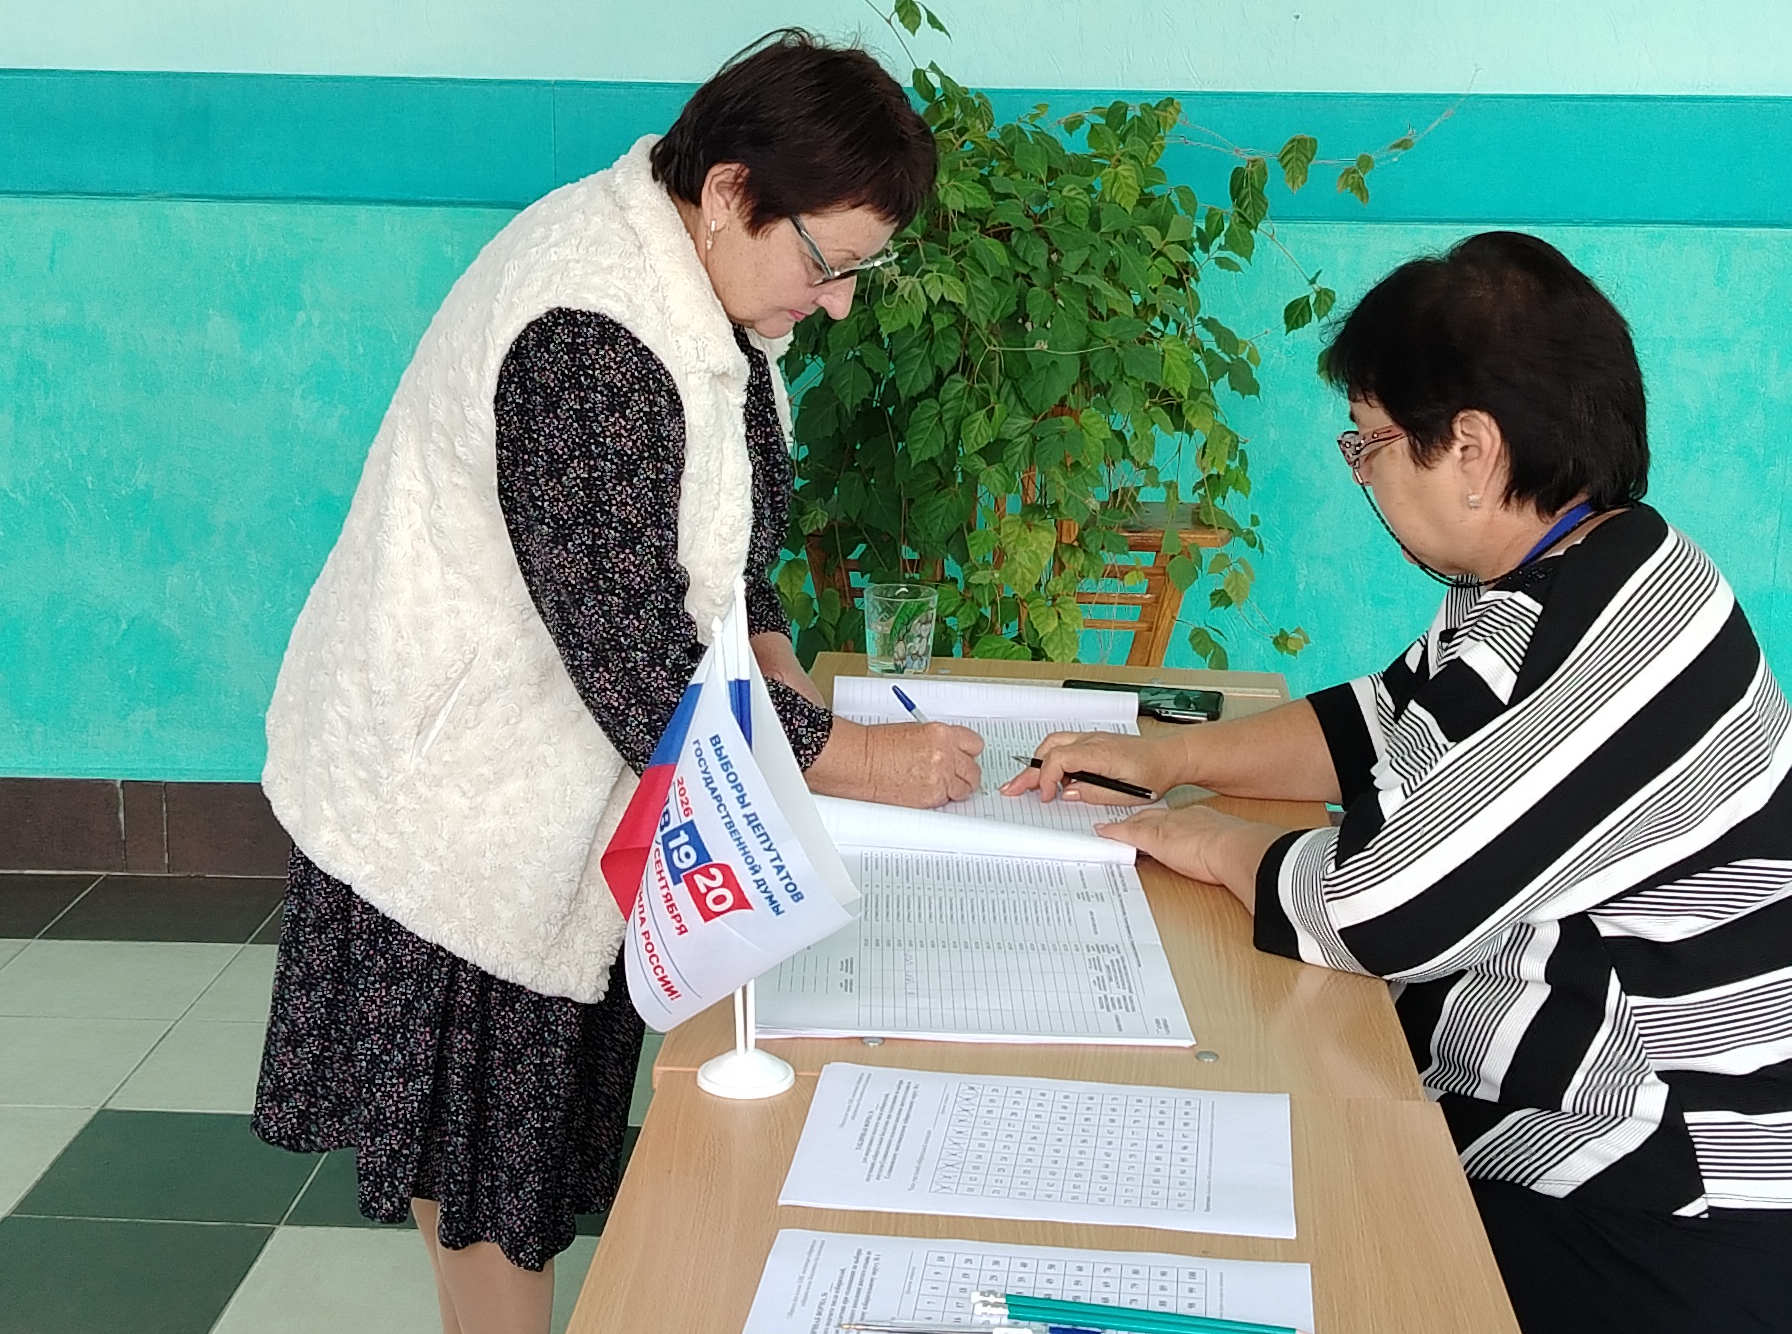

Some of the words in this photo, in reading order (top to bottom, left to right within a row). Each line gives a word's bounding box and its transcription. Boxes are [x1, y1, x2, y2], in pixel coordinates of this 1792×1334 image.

[677, 776, 693, 818] 2026
[692, 738, 762, 877] ГОСУДАРСТВЕННОЙ
[755, 874, 785, 917] ДУМЫ
[709, 732, 752, 818] ВЫБОРЫ
[747, 810, 805, 903] ДЕПУТАТОВ
[654, 847, 689, 936] СЕНТЯБРЯ
[668, 830, 697, 869] 19
[693, 867, 734, 912] 20
[641, 930, 682, 1001] РОССИИ!
